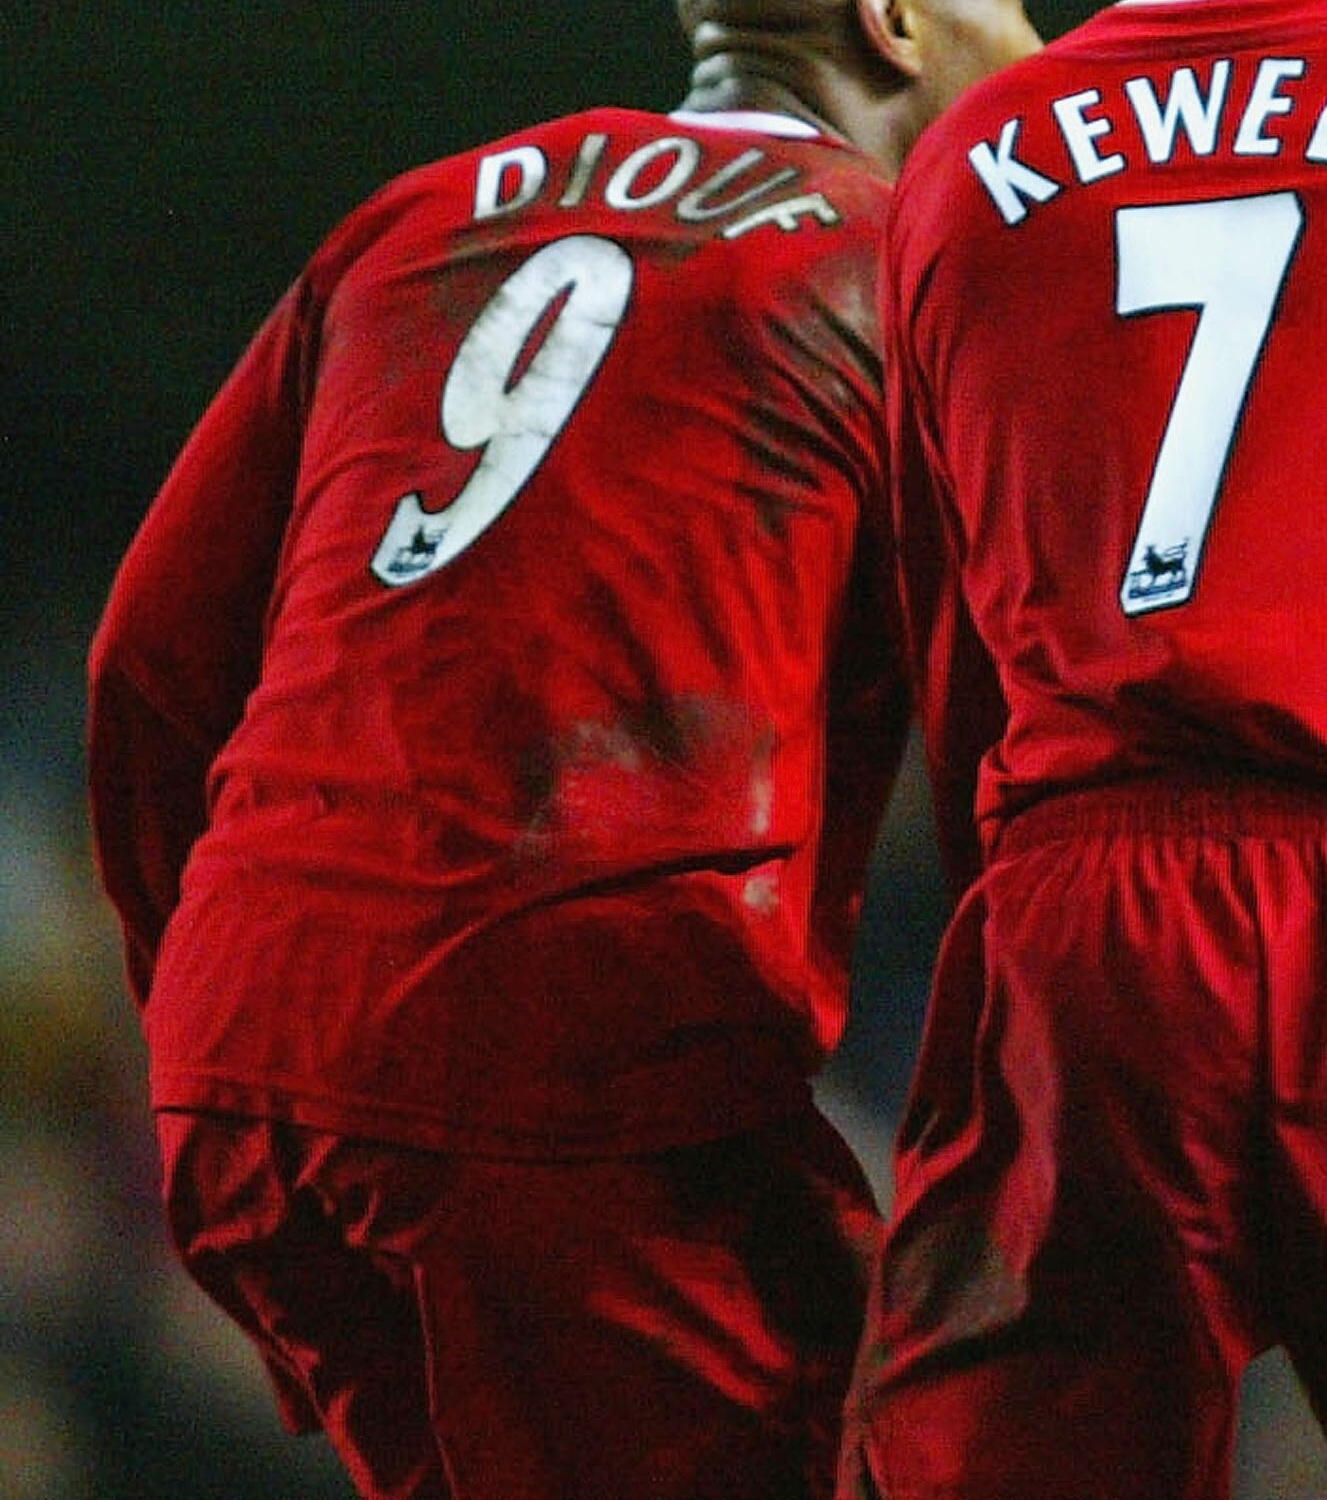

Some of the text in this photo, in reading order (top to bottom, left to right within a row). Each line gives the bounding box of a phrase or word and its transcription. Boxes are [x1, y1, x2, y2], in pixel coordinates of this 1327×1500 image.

[473, 134, 839, 239] DIOUF
[371, 234, 634, 586] 9
[1115, 191, 1305, 618] 7
